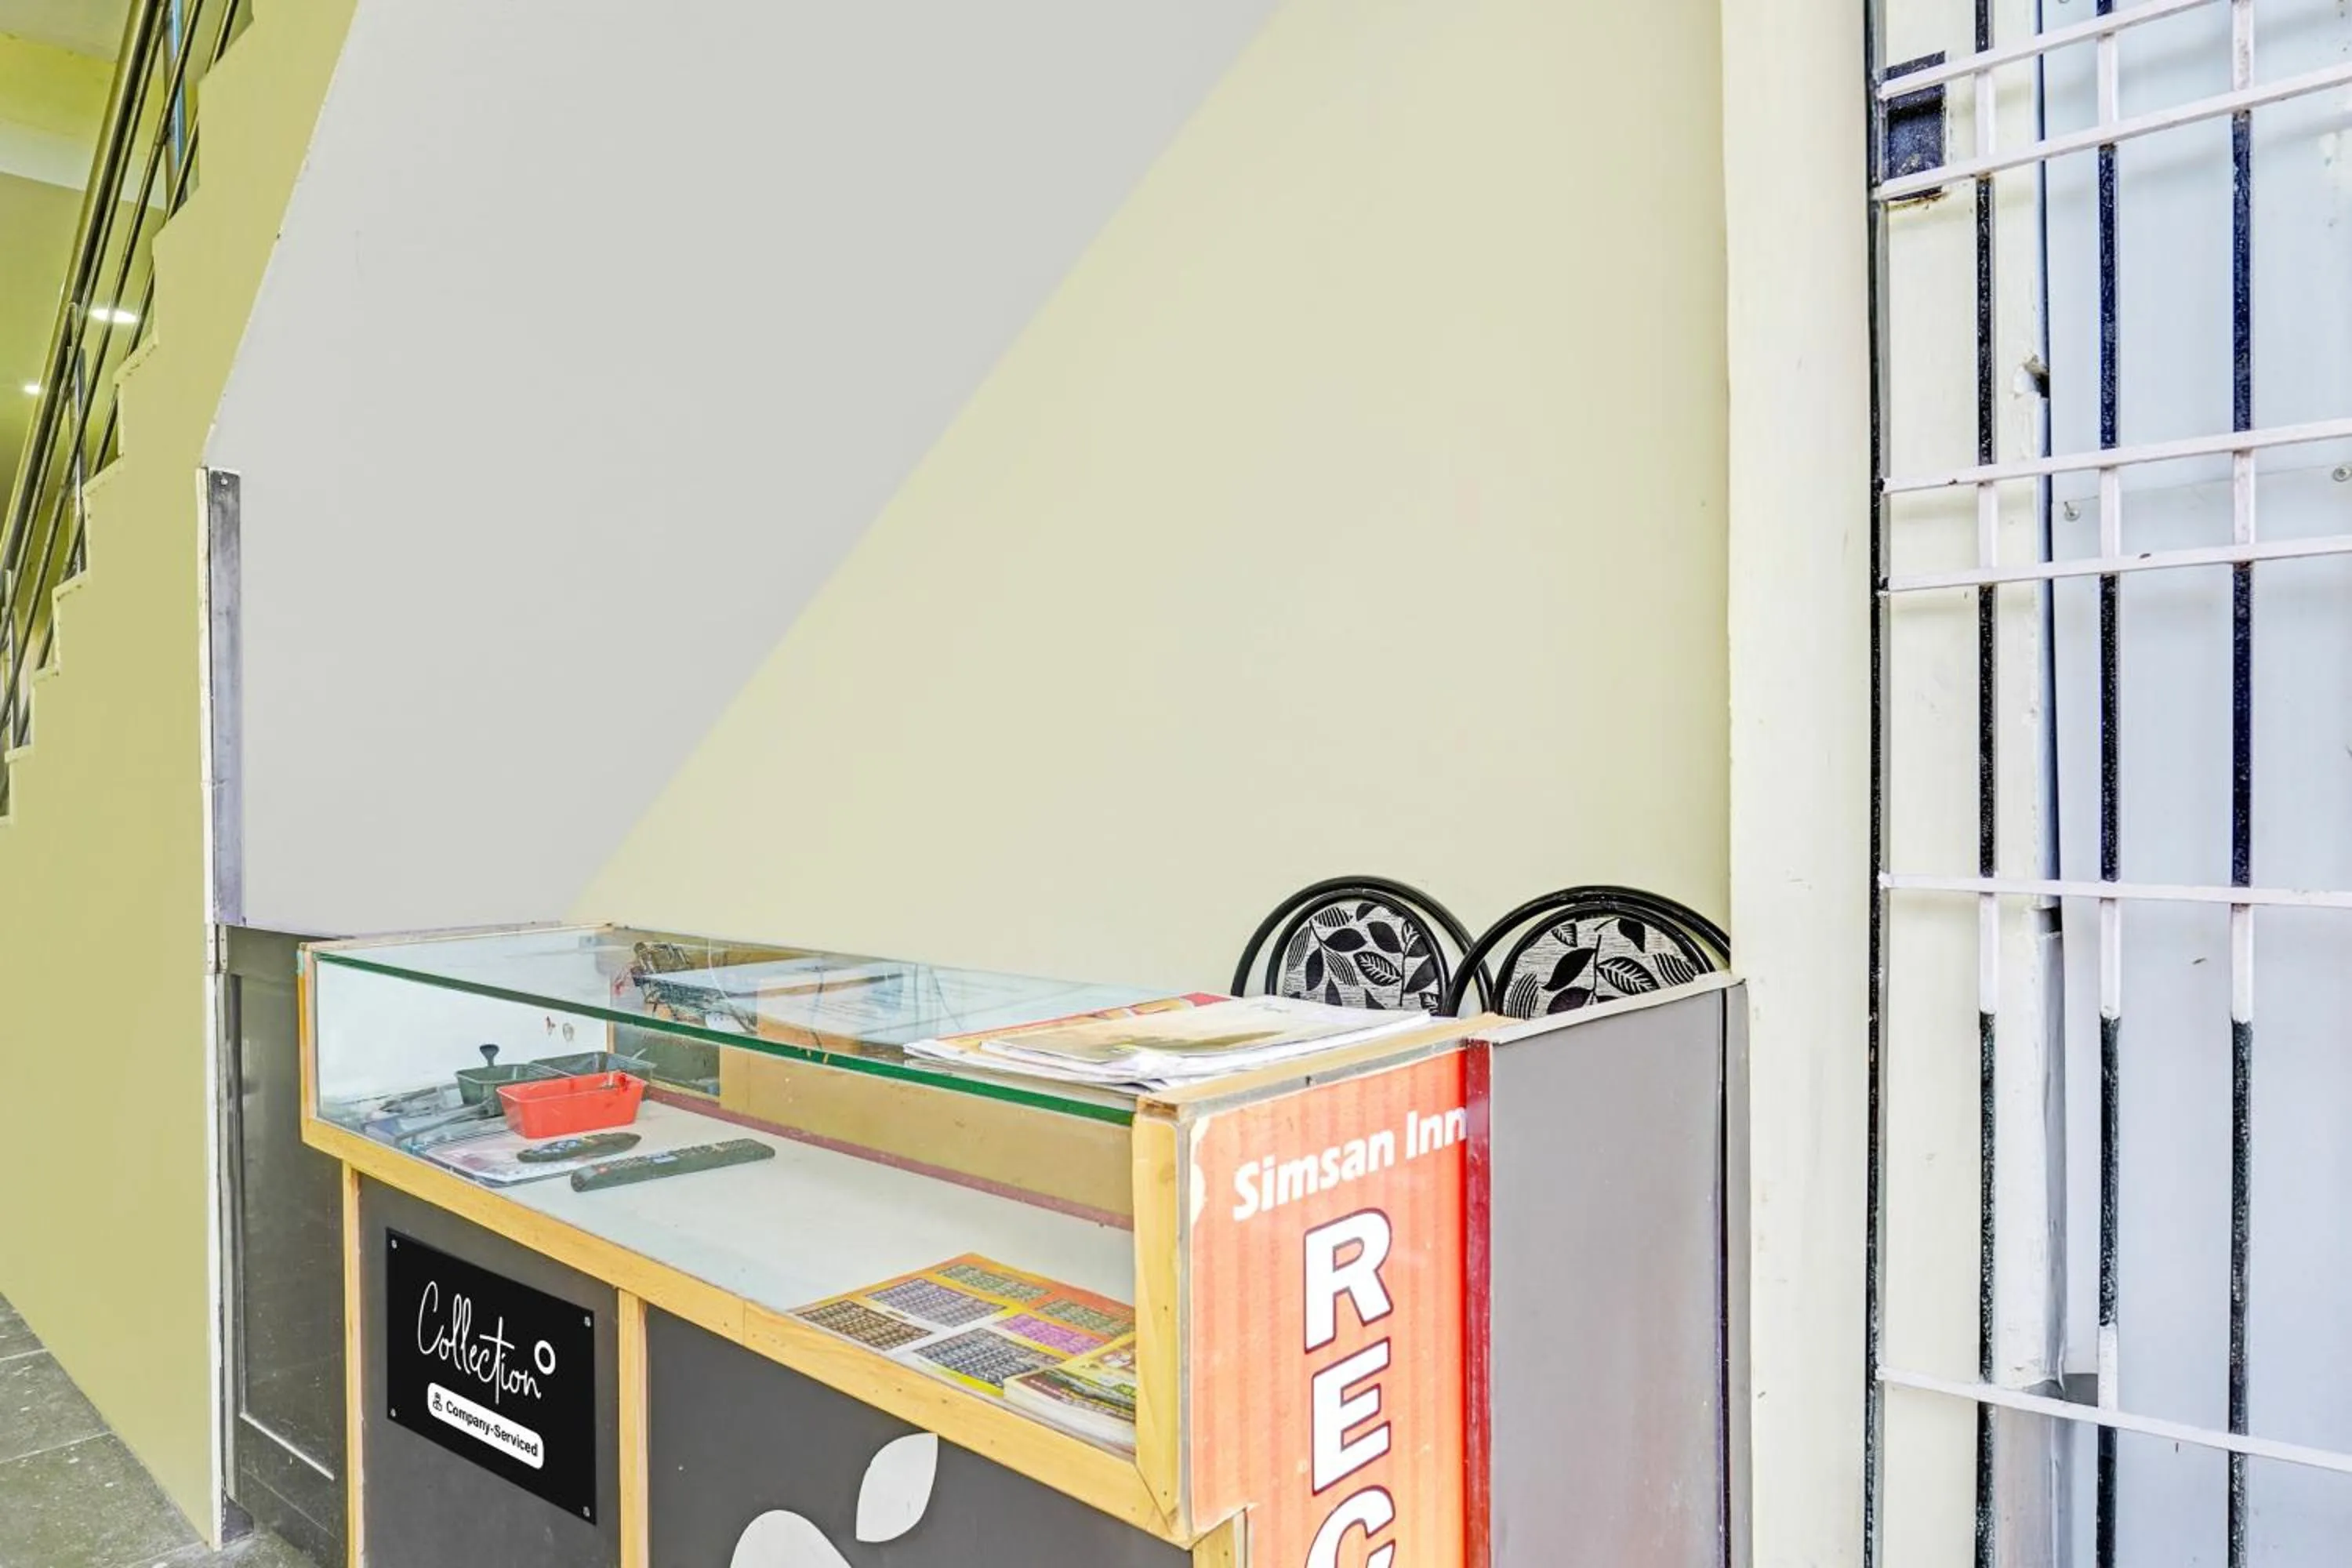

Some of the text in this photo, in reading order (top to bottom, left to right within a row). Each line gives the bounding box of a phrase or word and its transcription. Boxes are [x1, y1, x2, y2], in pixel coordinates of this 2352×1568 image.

[1232, 1106, 1467, 1221] Simsan Inn
[417, 1280, 542, 1406] Collection
[446, 1399, 539, 1457] Company-Serviced
